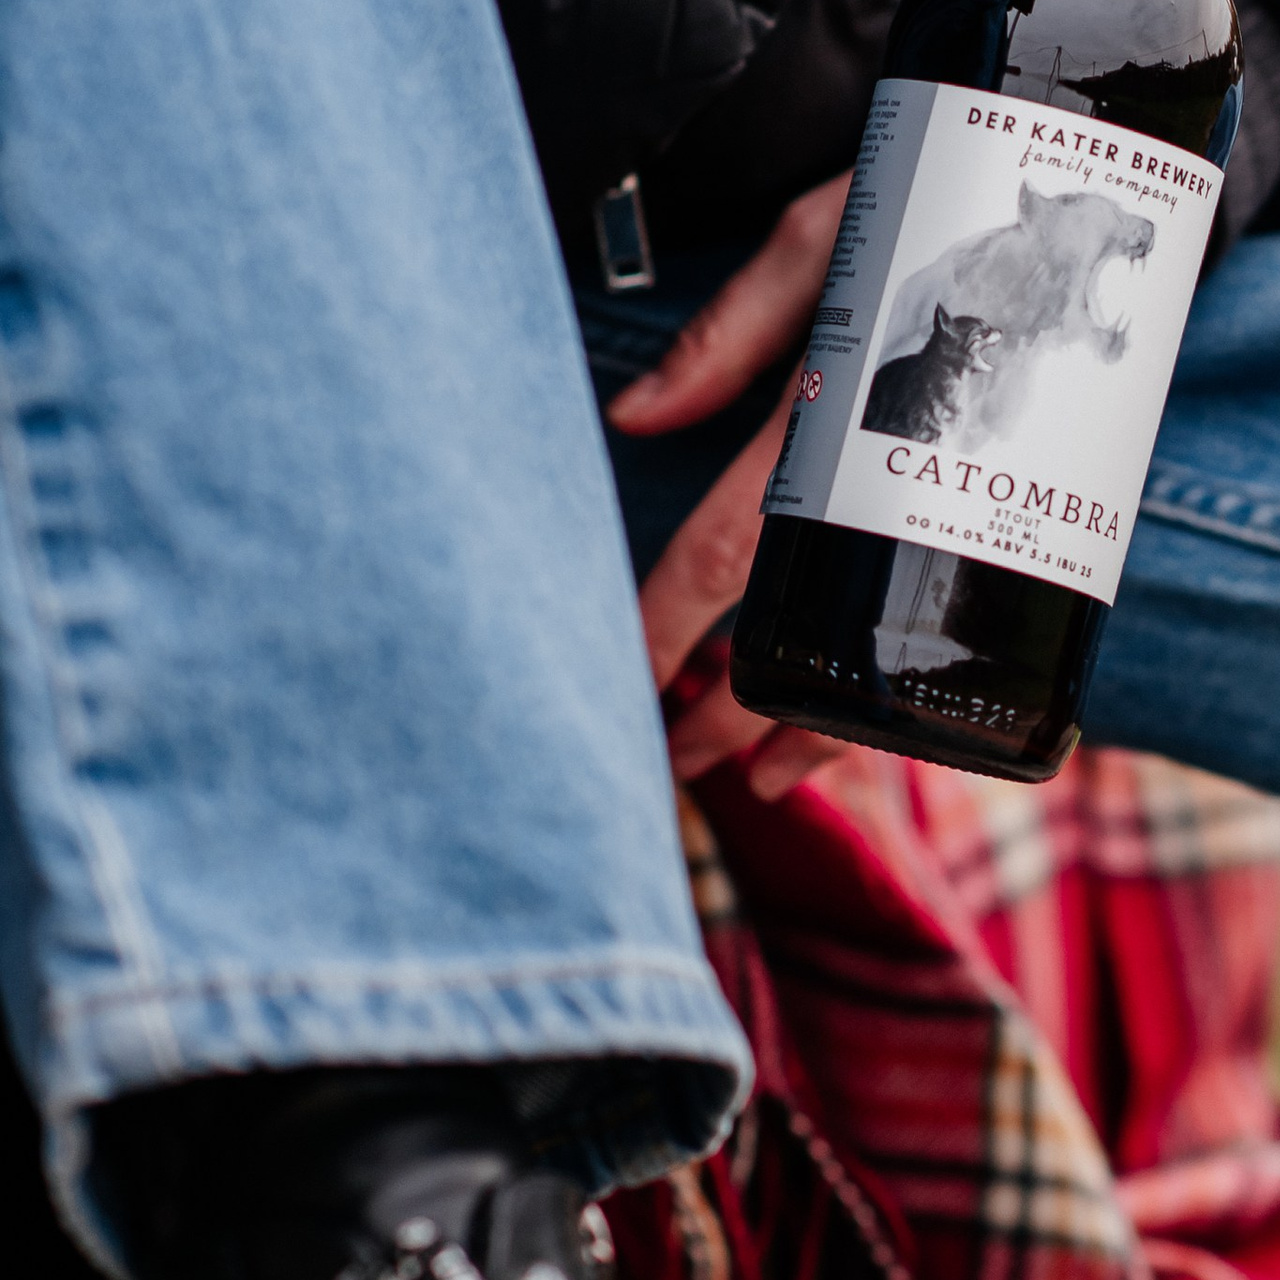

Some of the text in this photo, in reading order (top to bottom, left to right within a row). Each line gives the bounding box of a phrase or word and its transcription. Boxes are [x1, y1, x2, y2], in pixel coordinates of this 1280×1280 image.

[967, 107, 1213, 200] DER KATER BREWERY
[1019, 144, 1179, 213] family company
[886, 447, 1120, 541] CATOMBRA
[994, 507, 1042, 529] STOUT
[906, 514, 1093, 578] OG 14.0% ABV 5.5 IBU 25
[987, 520, 1040, 545] 500 ML
